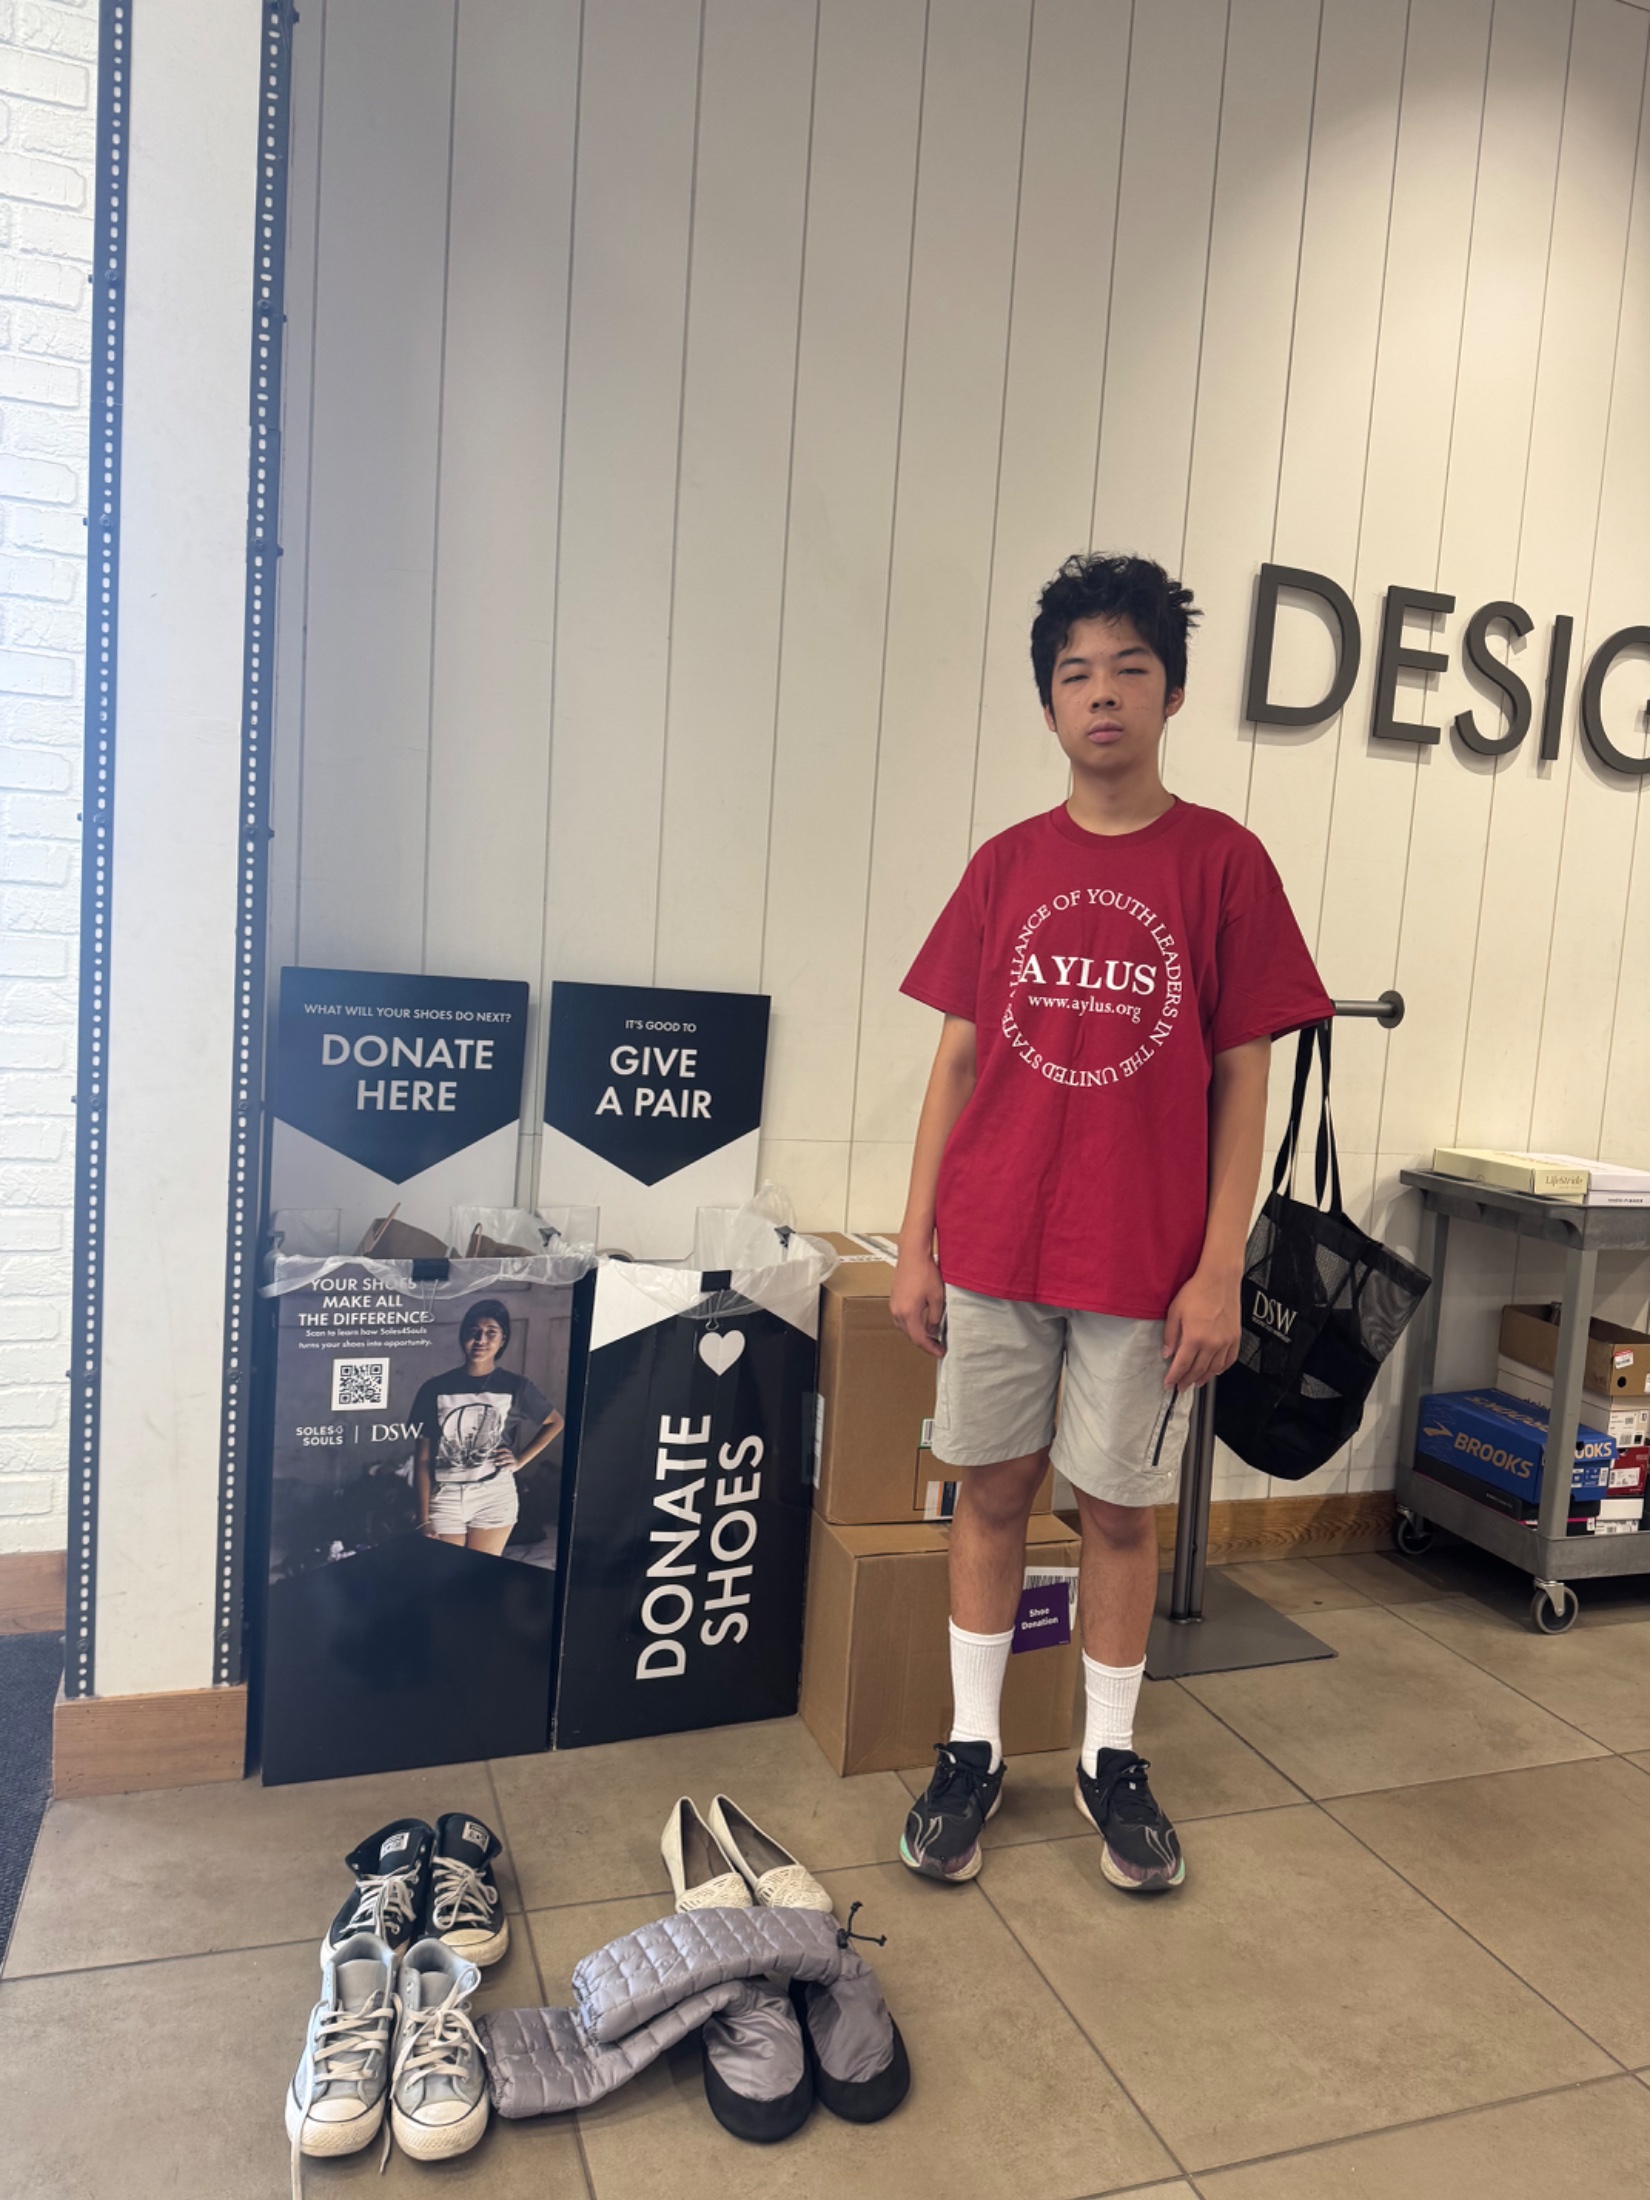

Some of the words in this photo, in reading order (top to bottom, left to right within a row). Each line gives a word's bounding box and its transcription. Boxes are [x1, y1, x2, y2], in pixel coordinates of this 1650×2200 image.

[1052, 890, 1081, 911] OF
[1087, 888, 1158, 927] YOUTH
[1020, 953, 1158, 995] AYLUS
[1150, 923, 1183, 1018] LEADERS
[304, 1003, 342, 1015] WHAT
[345, 1006, 373, 1017] WILL
[376, 1007, 411, 1019] YOUR
[413, 1009, 453, 1021] SHOES
[455, 1010, 474, 1021] DO
[476, 1012, 512, 1023] NEXT?
[1027, 995, 1142, 1024] www.aylus.org
[625, 1019, 643, 1030] IT'S
[645, 1021, 681, 1032] GOOD
[682, 1022, 697, 1033] TO
[1001, 1003, 1043, 1070] STATE
[1149, 1019, 1174, 1046] IN
[321, 1033, 495, 1070] DONATE
[609, 1044, 698, 1078] GIVE
[1119, 1044, 1155, 1078] THE
[1041, 1061, 1119, 1088] UNITED
[356, 1079, 458, 1112] HERE
[594, 1086, 624, 1116] A
[634, 1087, 713, 1119] PAIR
[311, 1278, 358, 1291] YOUR
[322, 1295, 371, 1309] MAKE
[375, 1294, 404, 1307] ALL
[1253, 1290, 1299, 1335] DSW
[298, 1313, 329, 1327] THE
[333, 1311, 432, 1326] DIFFERENCE
[306, 1329, 326, 1338] Scan
[327, 1329, 336, 1337] to
[337, 1328, 359, 1337] learn
[360, 1327, 378, 1336] how
[298, 1341, 320, 1350] turns
[321, 1341, 340, 1350] your
[342, 1339, 365, 1348] shoes
[366, 1339, 382, 1347] into
[383, 1338, 433, 1349] opportunity.
[303, 1436, 343, 1447] SOULS
[371, 1422, 424, 1442] DSW
[1453, 1431, 1534, 1479] BROOKS
[635, 1414, 712, 1681] DONATE
[700, 1434, 765, 1646] SHOES
[1021, 1616, 1060, 1630] Donation
[1029, 1607, 1050, 1618] Shoe
